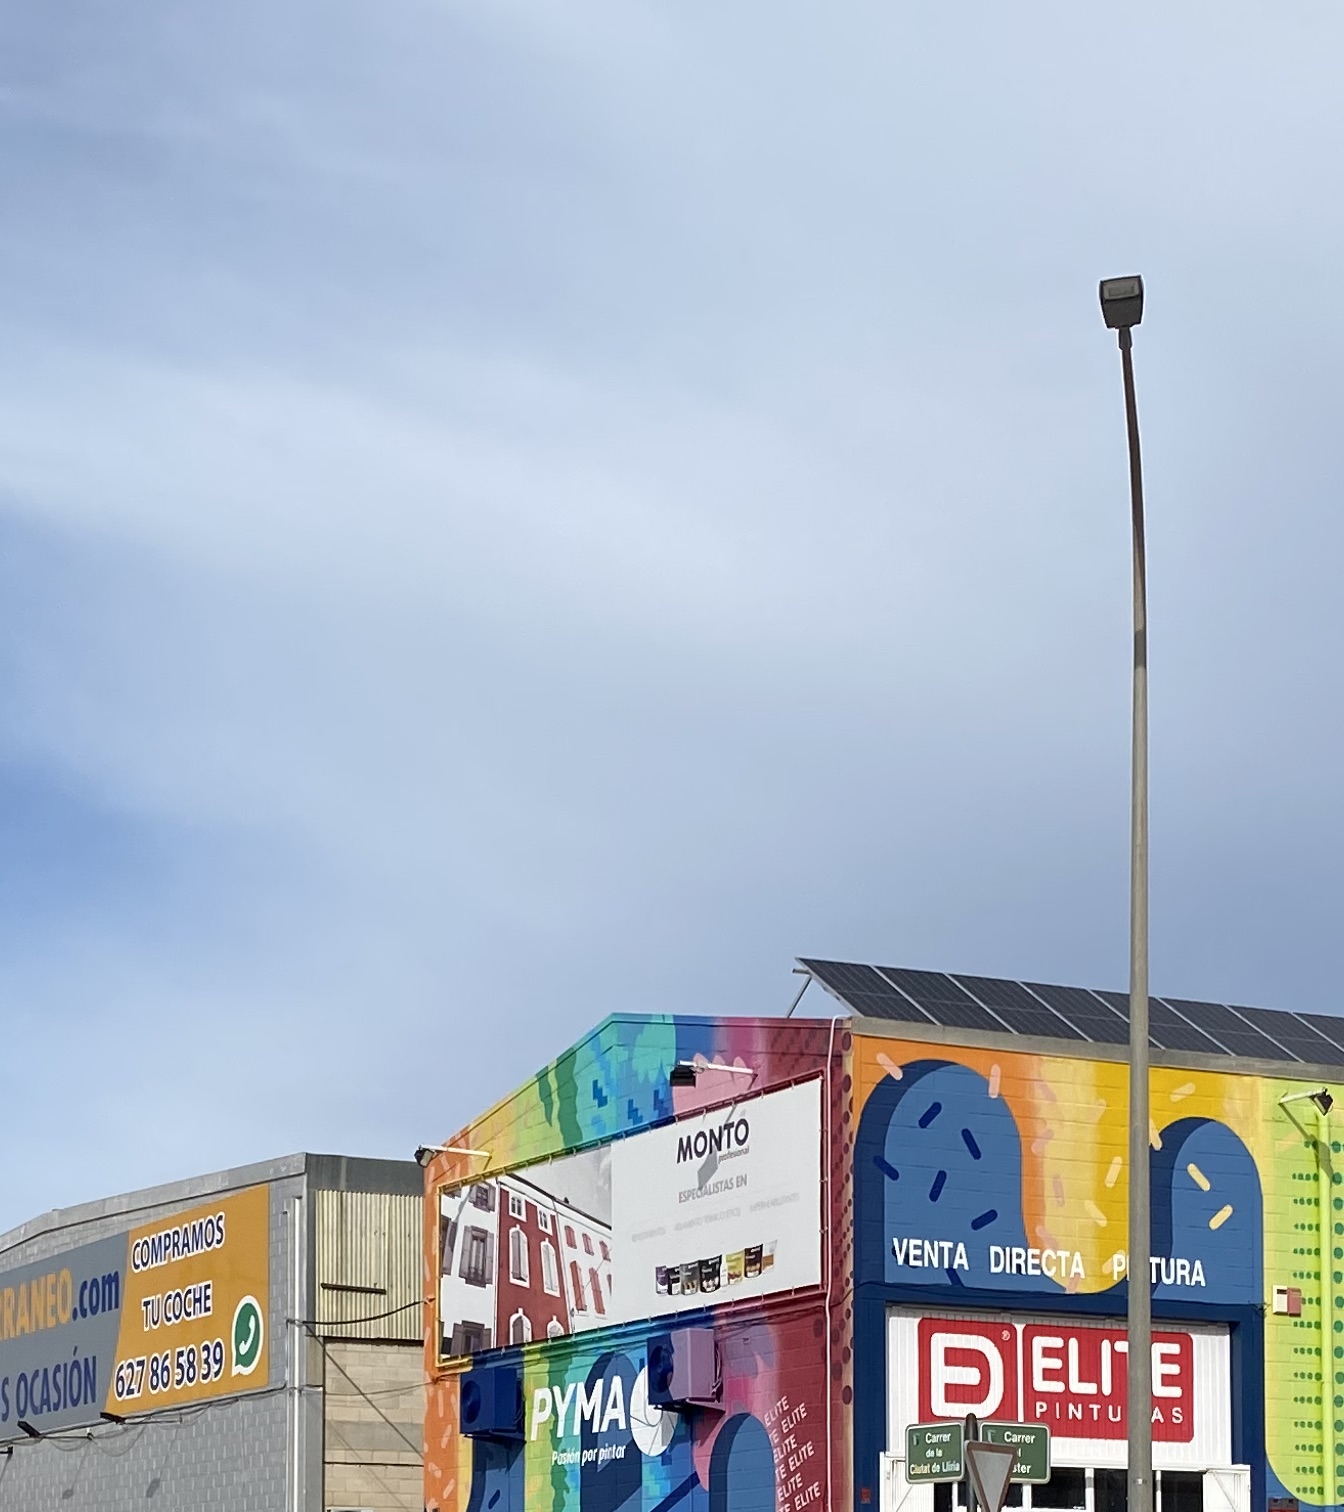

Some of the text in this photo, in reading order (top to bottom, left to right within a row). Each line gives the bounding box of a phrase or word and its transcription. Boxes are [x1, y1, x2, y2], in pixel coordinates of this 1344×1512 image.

[677, 1118, 750, 1164] MONTO
[718, 1147, 750, 1164] profesional
[678, 1180, 734, 1204] ESPECIALISTAS
[736, 1174, 748, 1189] EN
[131, 1213, 224, 1271] COMPRAMOS
[893, 1237, 1207, 1288] VENTA DIRECTA PITURA
[143, 1283, 212, 1330] TU COCHE
[16, 1345, 97, 1419] OCASIÓN
[115, 1341, 224, 1398] 627 86 58 39
[530, 1375, 627, 1441] PYMA
[764, 1396, 790, 1427] ELITE
[781, 1403, 808, 1433] ELITE
[1036, 1401, 1184, 1425] PINTUAS
[773, 1433, 798, 1464] ELITE
[925, 1432, 951, 1444] Carrer
[1004, 1431, 1036, 1444] Carrer
[552, 1443, 626, 1467] Pasión por pintar
[788, 1441, 814, 1472] ELITE
[931, 1462, 941, 1473] de
[1012, 1462, 1032, 1474] ster
[777, 1473, 803, 1503] ELITE
[794, 1481, 821, 1511] ELITE
